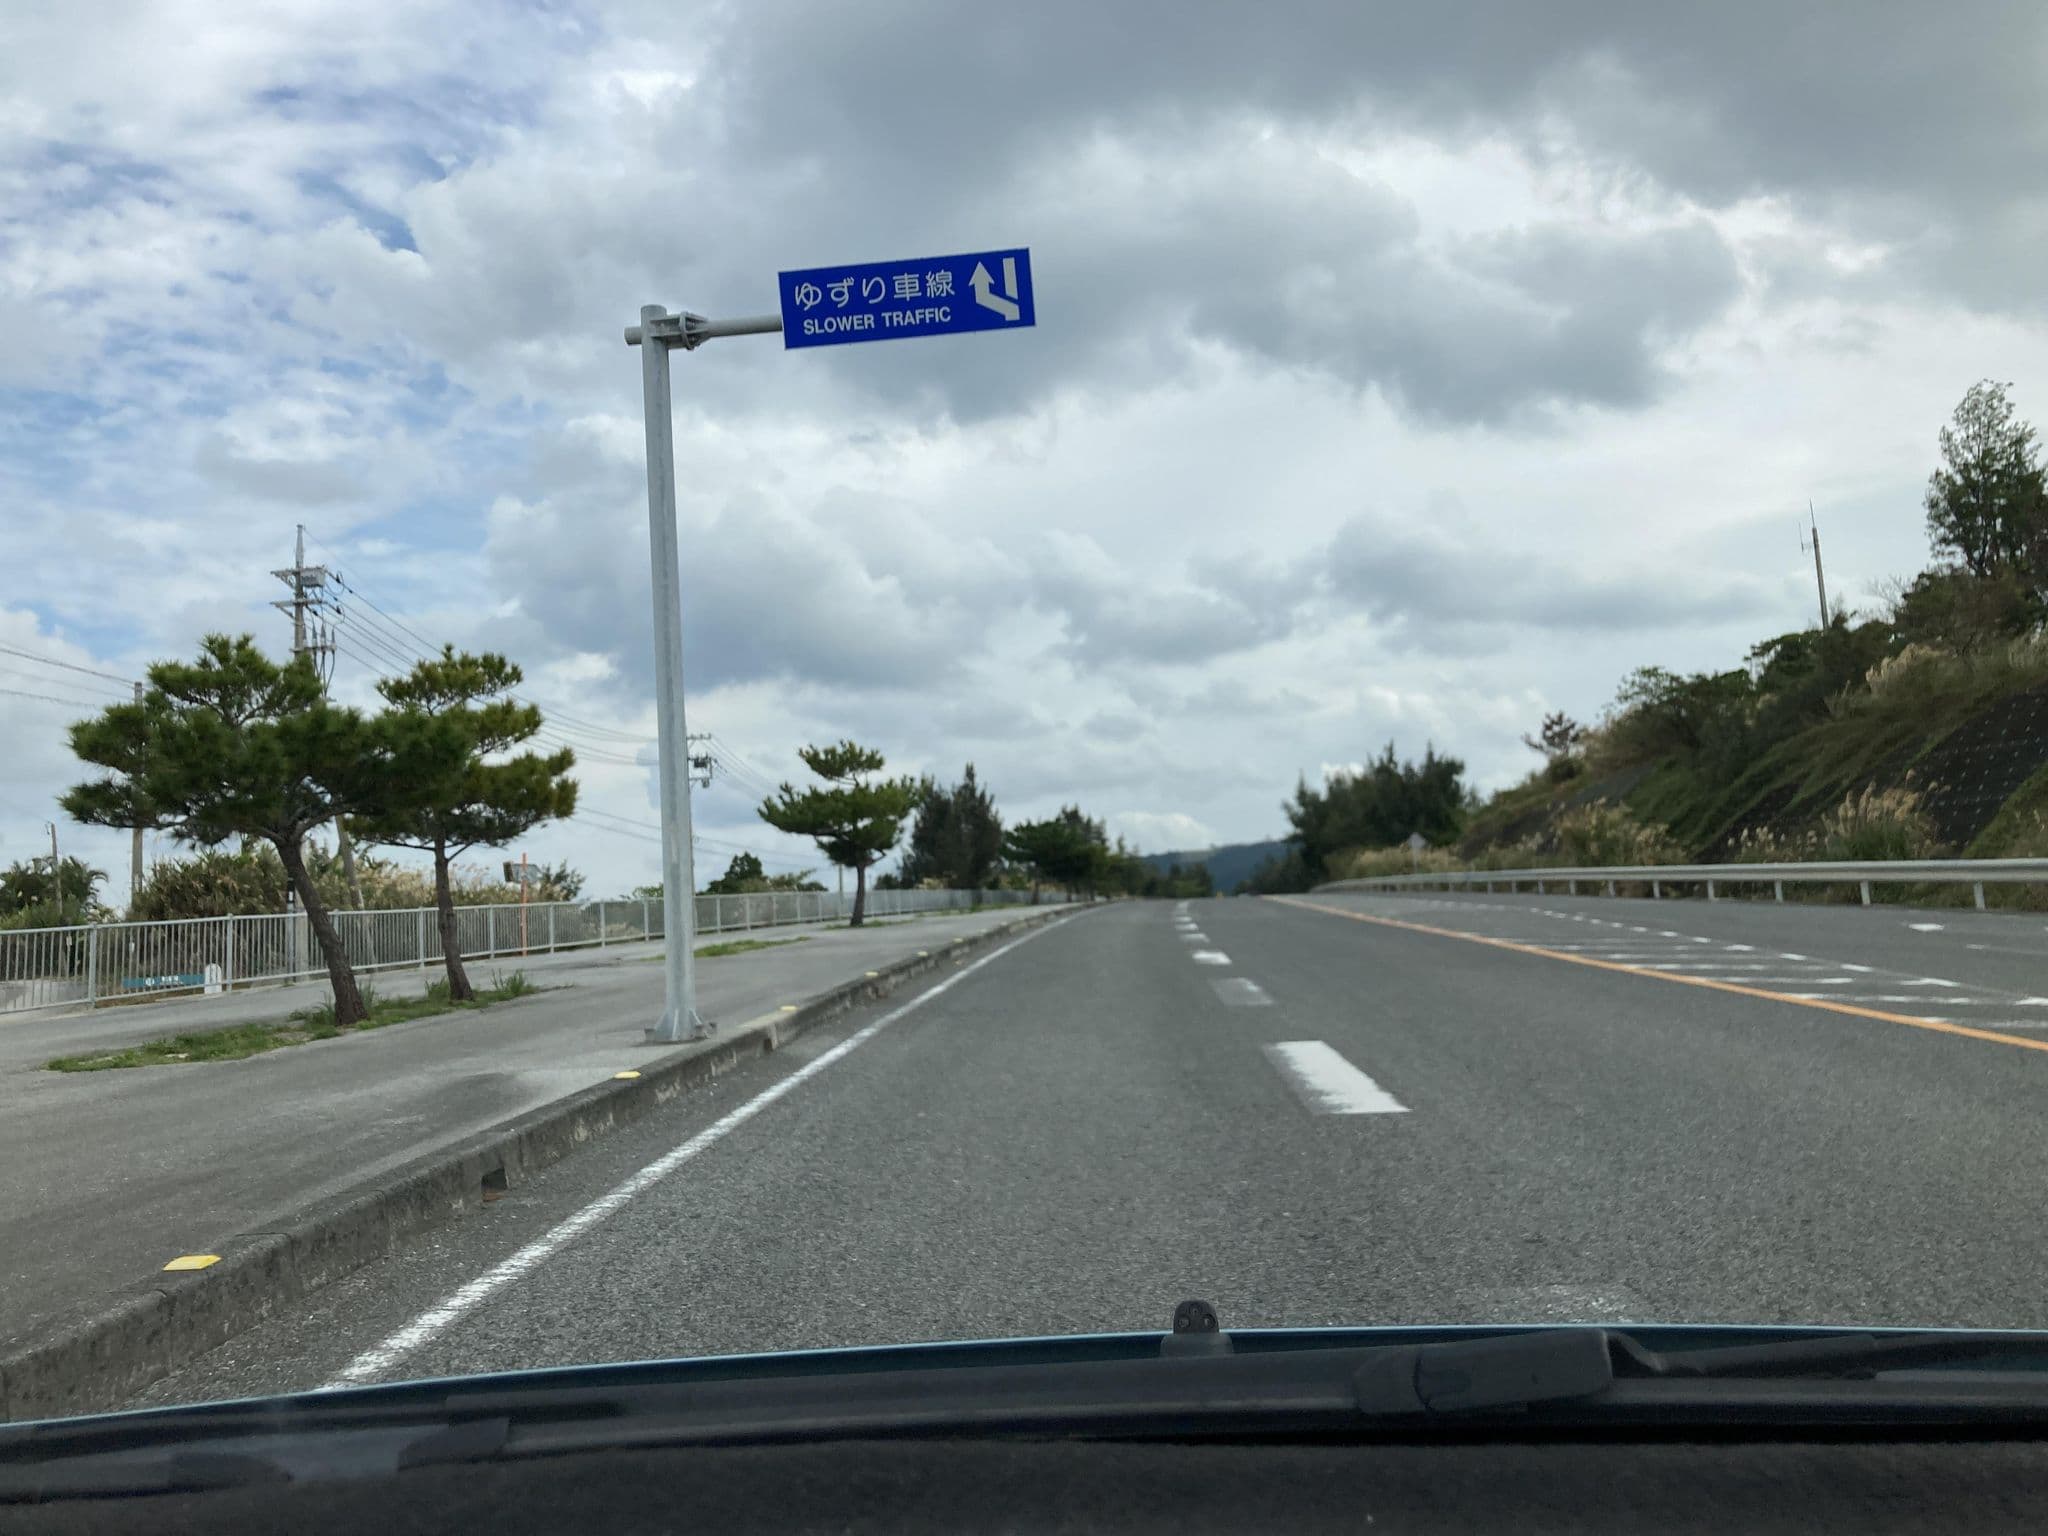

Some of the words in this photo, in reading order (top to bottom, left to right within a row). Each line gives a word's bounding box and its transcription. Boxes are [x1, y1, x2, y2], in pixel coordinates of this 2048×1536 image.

[794, 269, 956, 311] ゆずり車線
[803, 313, 875, 335] SLOWER
[881, 306, 951, 328] TRAFFIC
